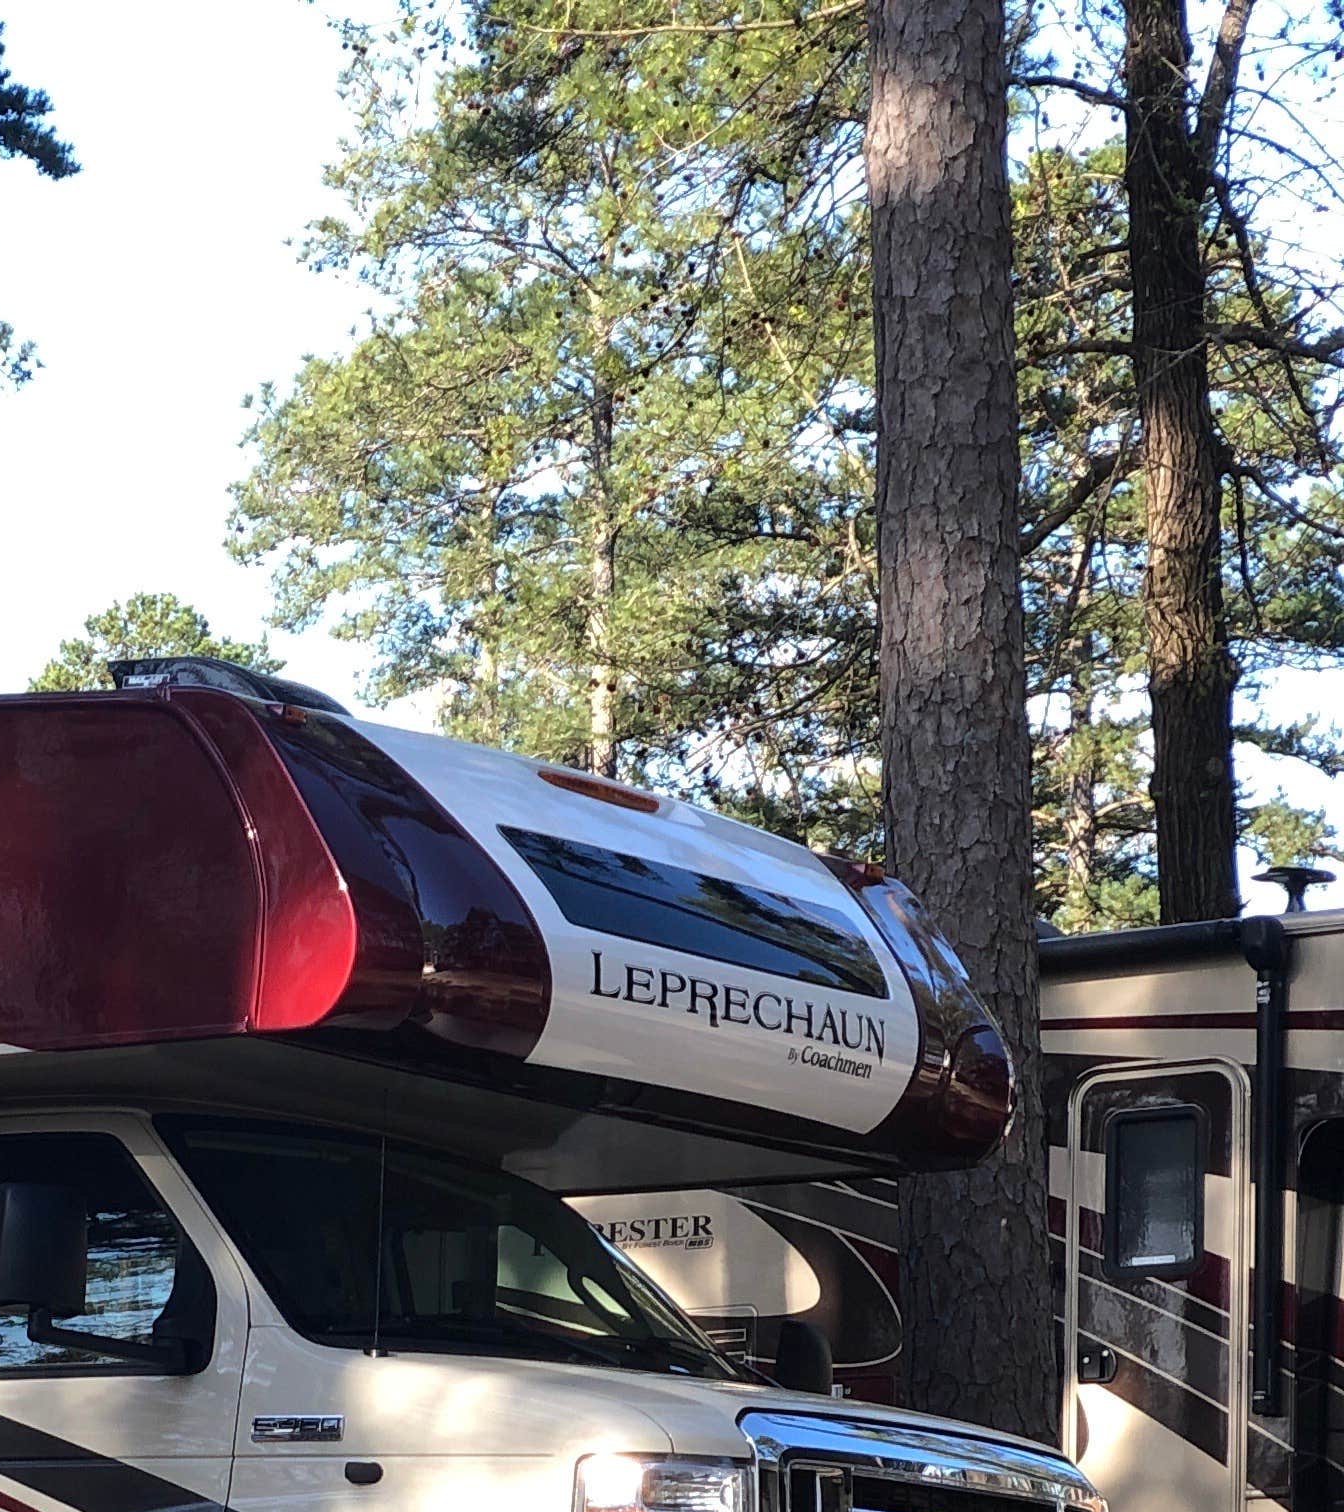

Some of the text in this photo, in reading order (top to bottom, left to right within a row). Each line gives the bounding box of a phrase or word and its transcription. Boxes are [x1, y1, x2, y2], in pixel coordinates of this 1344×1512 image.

[590, 949, 886, 1065] LEPRECHAUN
[787, 1045, 871, 1079] By Coachmen
